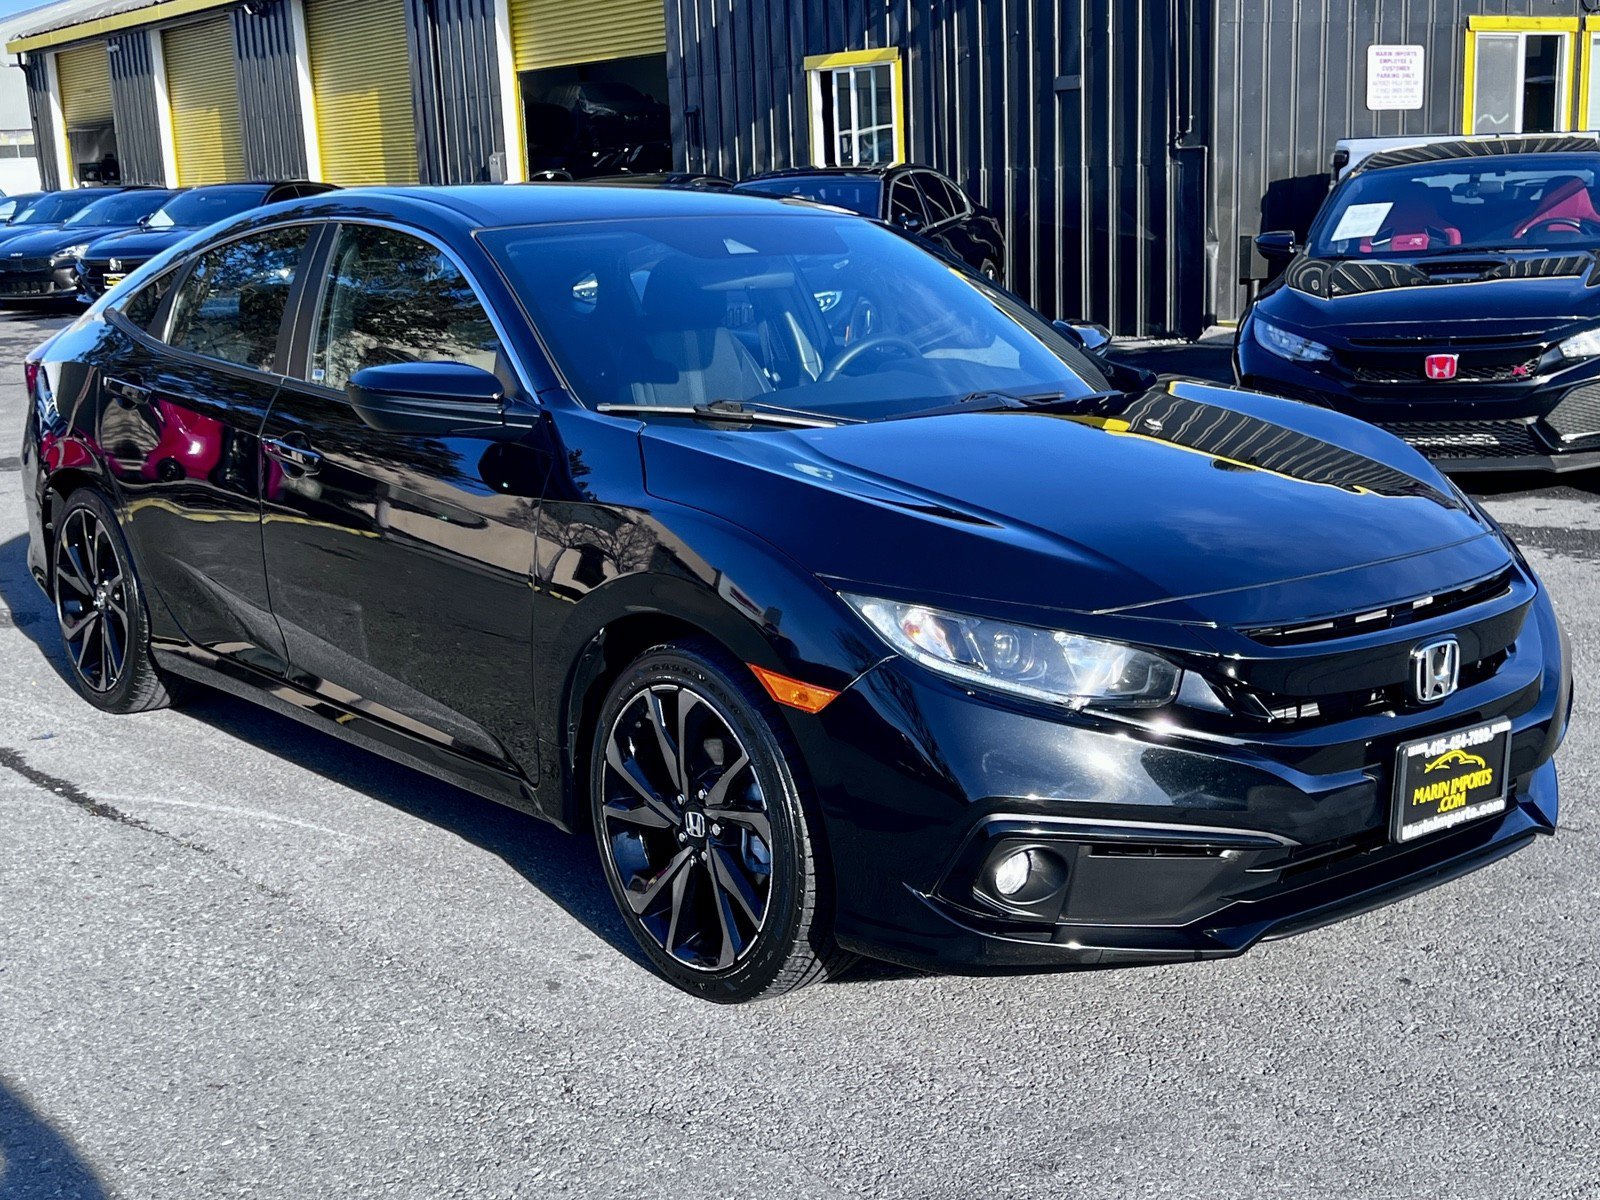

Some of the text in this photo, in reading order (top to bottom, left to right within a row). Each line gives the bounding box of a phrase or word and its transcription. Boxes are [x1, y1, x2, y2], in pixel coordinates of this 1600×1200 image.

[1412, 768, 1493, 806] MARIN IMPORTS
[1437, 791, 1466, 813] .COM
